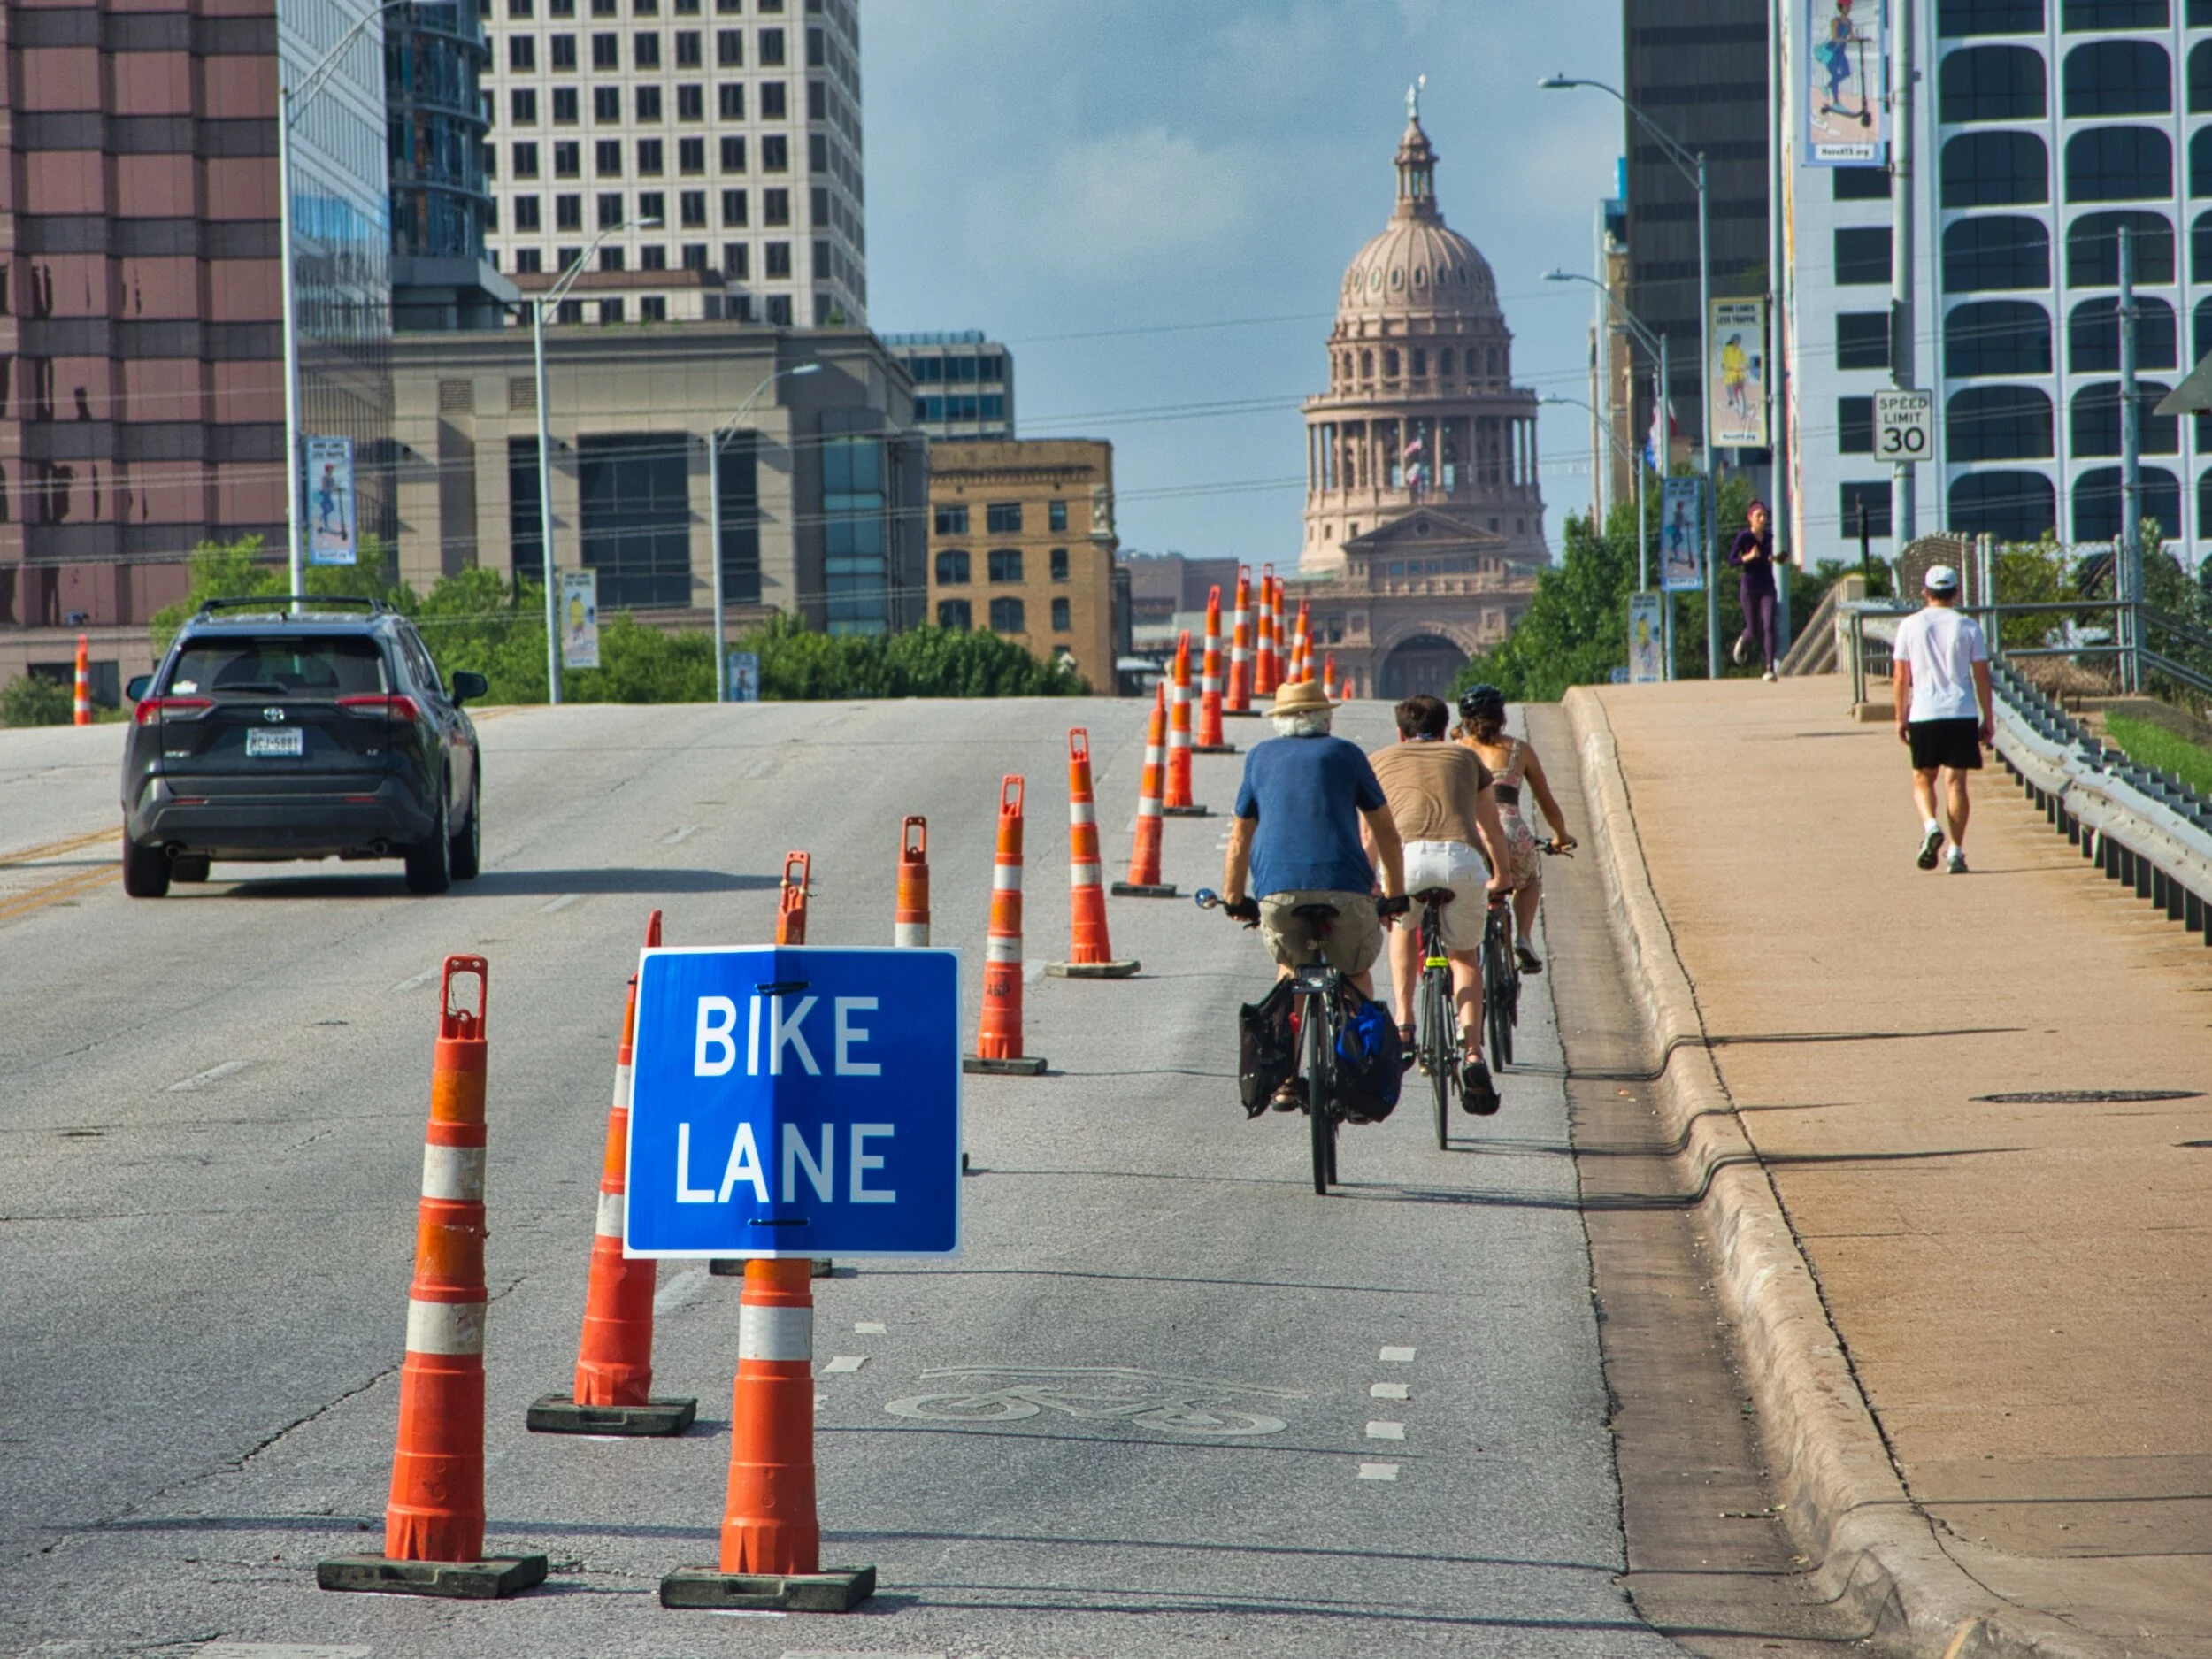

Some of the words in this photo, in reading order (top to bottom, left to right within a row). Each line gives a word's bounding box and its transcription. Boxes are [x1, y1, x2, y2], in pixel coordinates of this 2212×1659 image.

[1879, 396, 1927, 410] SPEED
[1884, 412, 1922, 424] LIMIT
[1882, 426, 1925, 453] 30
[694, 995, 881, 1077] BIKE
[676, 1122, 897, 1203] LANE
